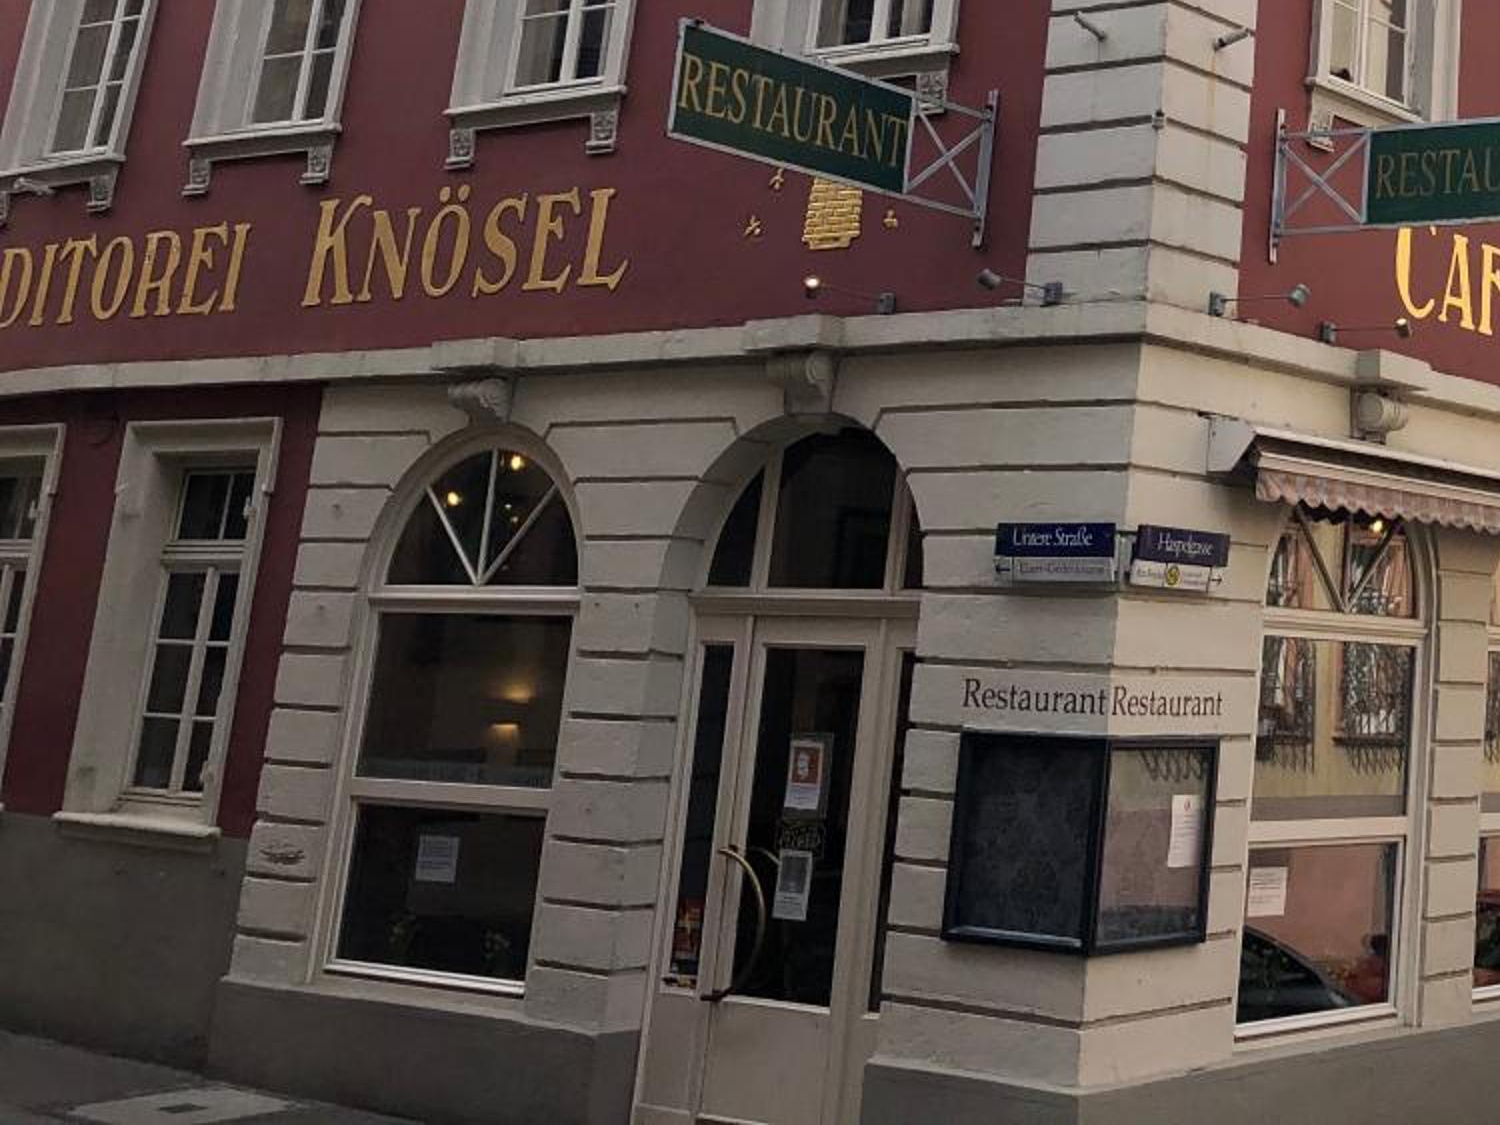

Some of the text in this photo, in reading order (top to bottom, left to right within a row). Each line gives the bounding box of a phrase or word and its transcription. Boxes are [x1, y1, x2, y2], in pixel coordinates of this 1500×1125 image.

[678, 53, 909, 167] RESTAURANT
[301, 183, 630, 308] KNÖSEL
[1012, 525, 1094, 547] Untere Straße
[962, 678, 1108, 715] Restaurant
[1111, 685, 1223, 717] Restaurant
